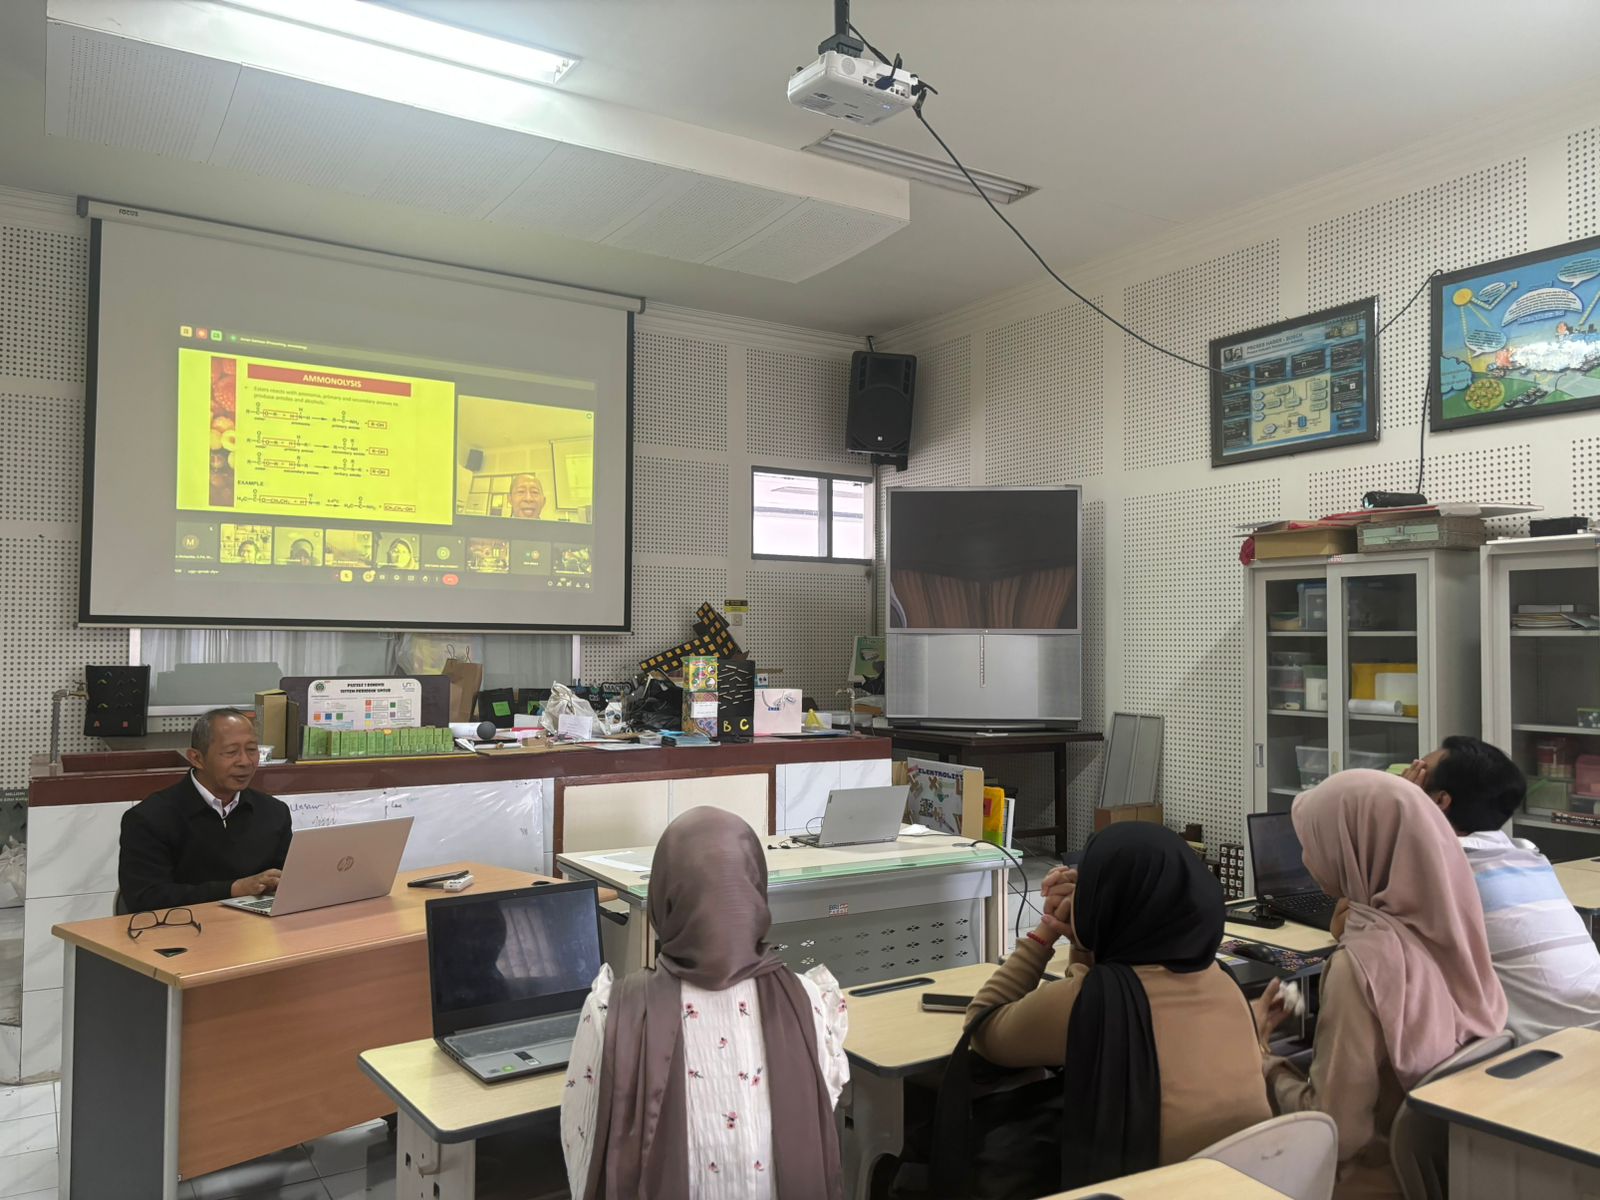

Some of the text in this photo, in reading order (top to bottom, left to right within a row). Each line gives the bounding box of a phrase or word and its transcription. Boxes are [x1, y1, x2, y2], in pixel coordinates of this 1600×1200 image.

[118, 208, 139, 217] FOCUS
[302, 374, 362, 388] AMMONOLYSIS
[723, 720, 732, 733] B
[739, 718, 749, 731] C
